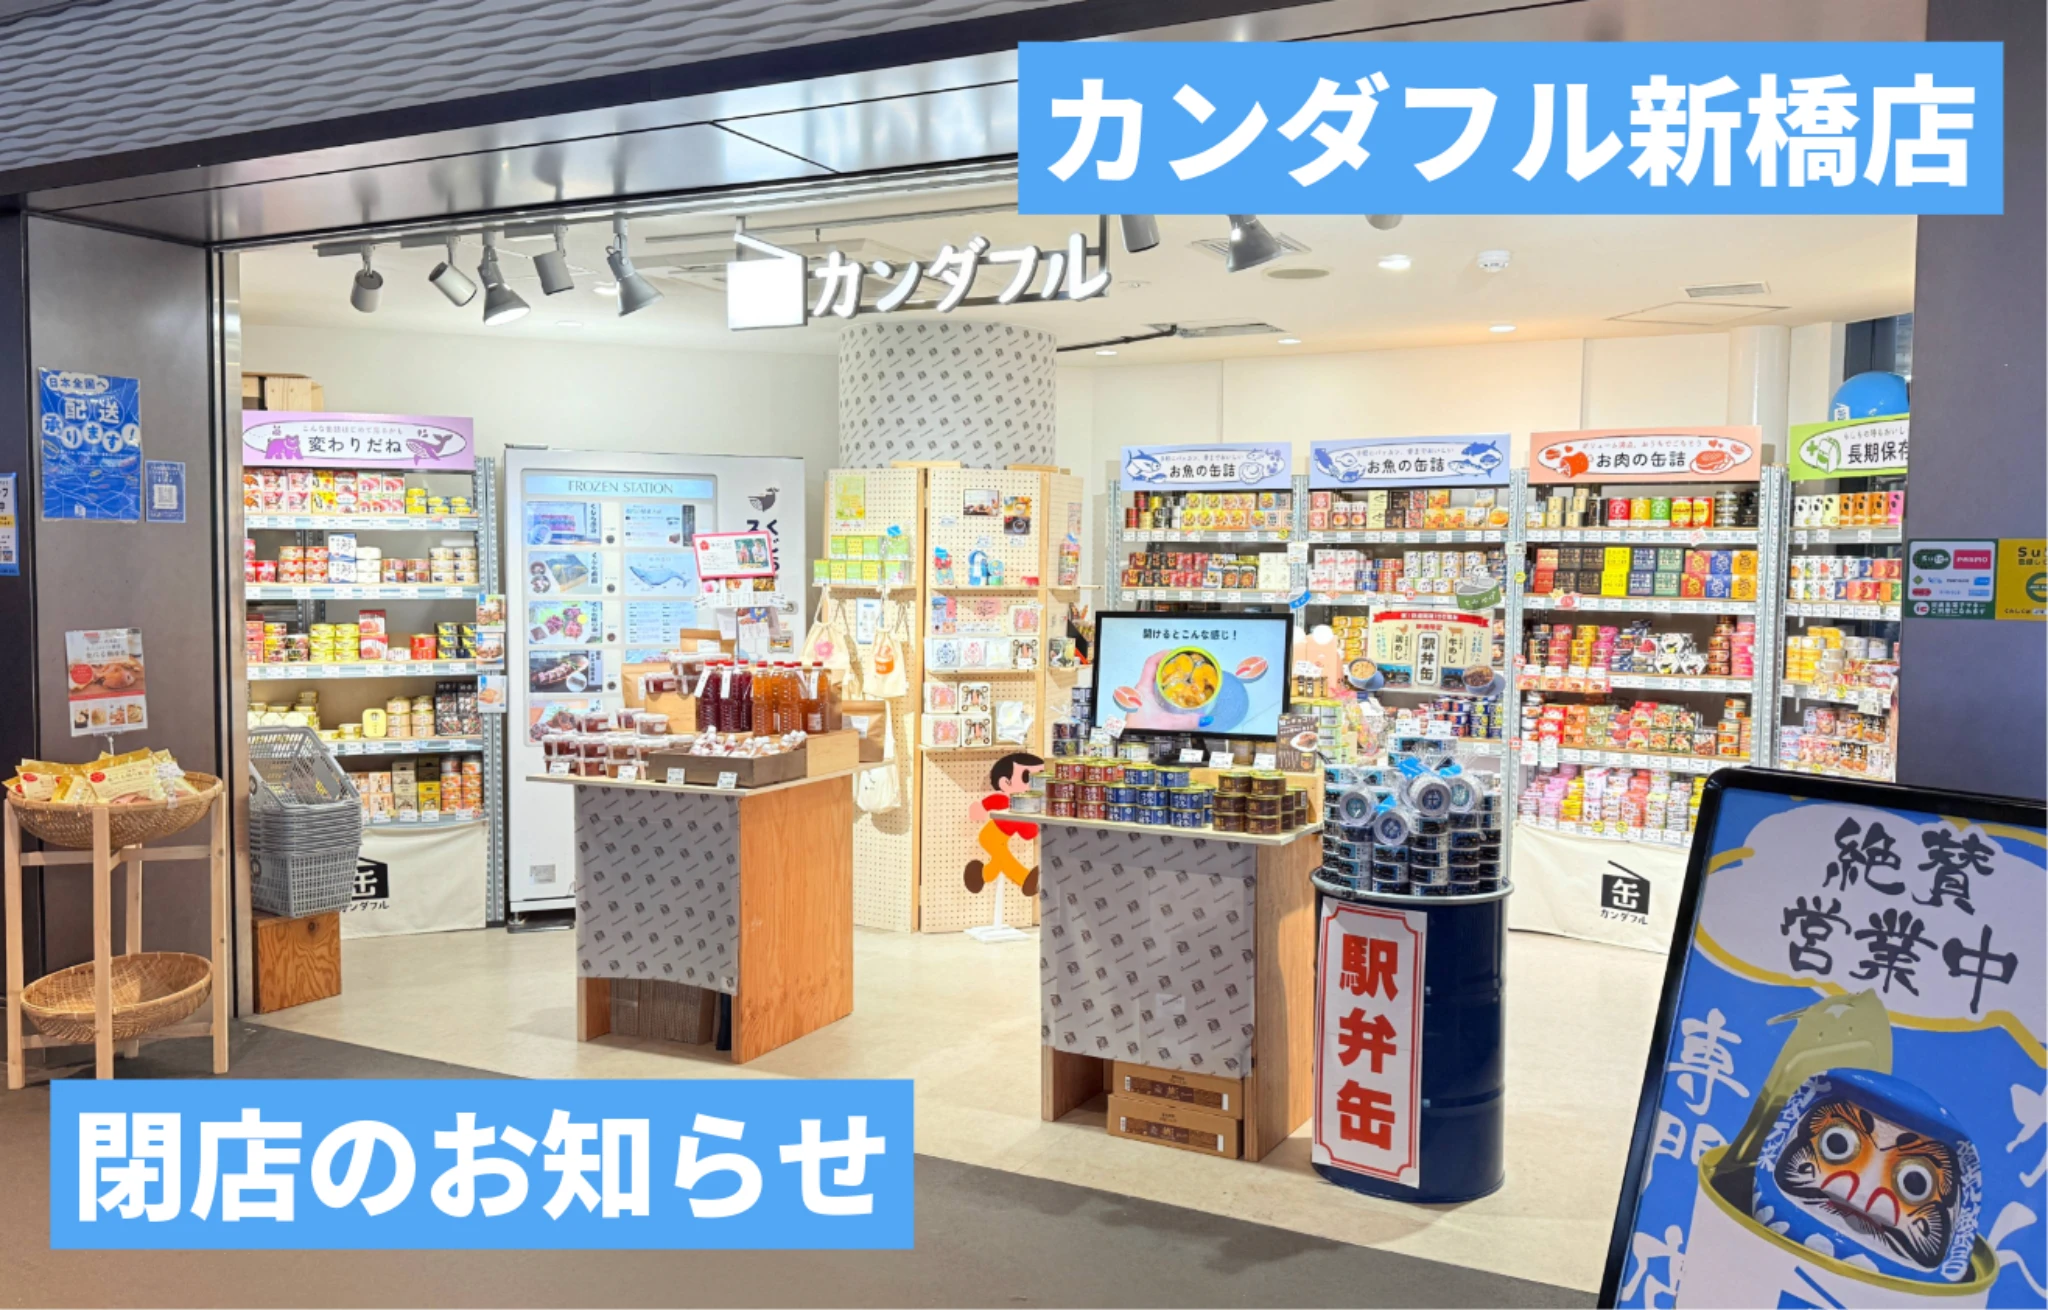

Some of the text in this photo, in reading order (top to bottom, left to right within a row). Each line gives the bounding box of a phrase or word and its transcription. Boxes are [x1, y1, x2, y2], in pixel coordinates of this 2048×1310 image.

[813, 233, 1111, 318] カンダフル
[50, 377, 107, 390] 日本全国へ
[65, 397, 119, 424] 配送
[308, 436, 402, 454] 変わりだね
[1596, 450, 1686, 467] お肉の缶詰
[1169, 463, 1236, 478] お魚の缶詰
[1367, 457, 1445, 474] お魚の缶詰
[568, 480, 673, 494] FROZEN STATION
[1420, 637, 1436, 681] 駅弁缶
[1448, 637, 1457, 664] 牛めし
[1822, 816, 1996, 915] 絶賛
[1611, 878, 1641, 909] 缶
[1600, 909, 1648, 925] カンダフル
[1781, 896, 2019, 1014] 営業中
[1337, 933, 1399, 1151] 駅弁缶
